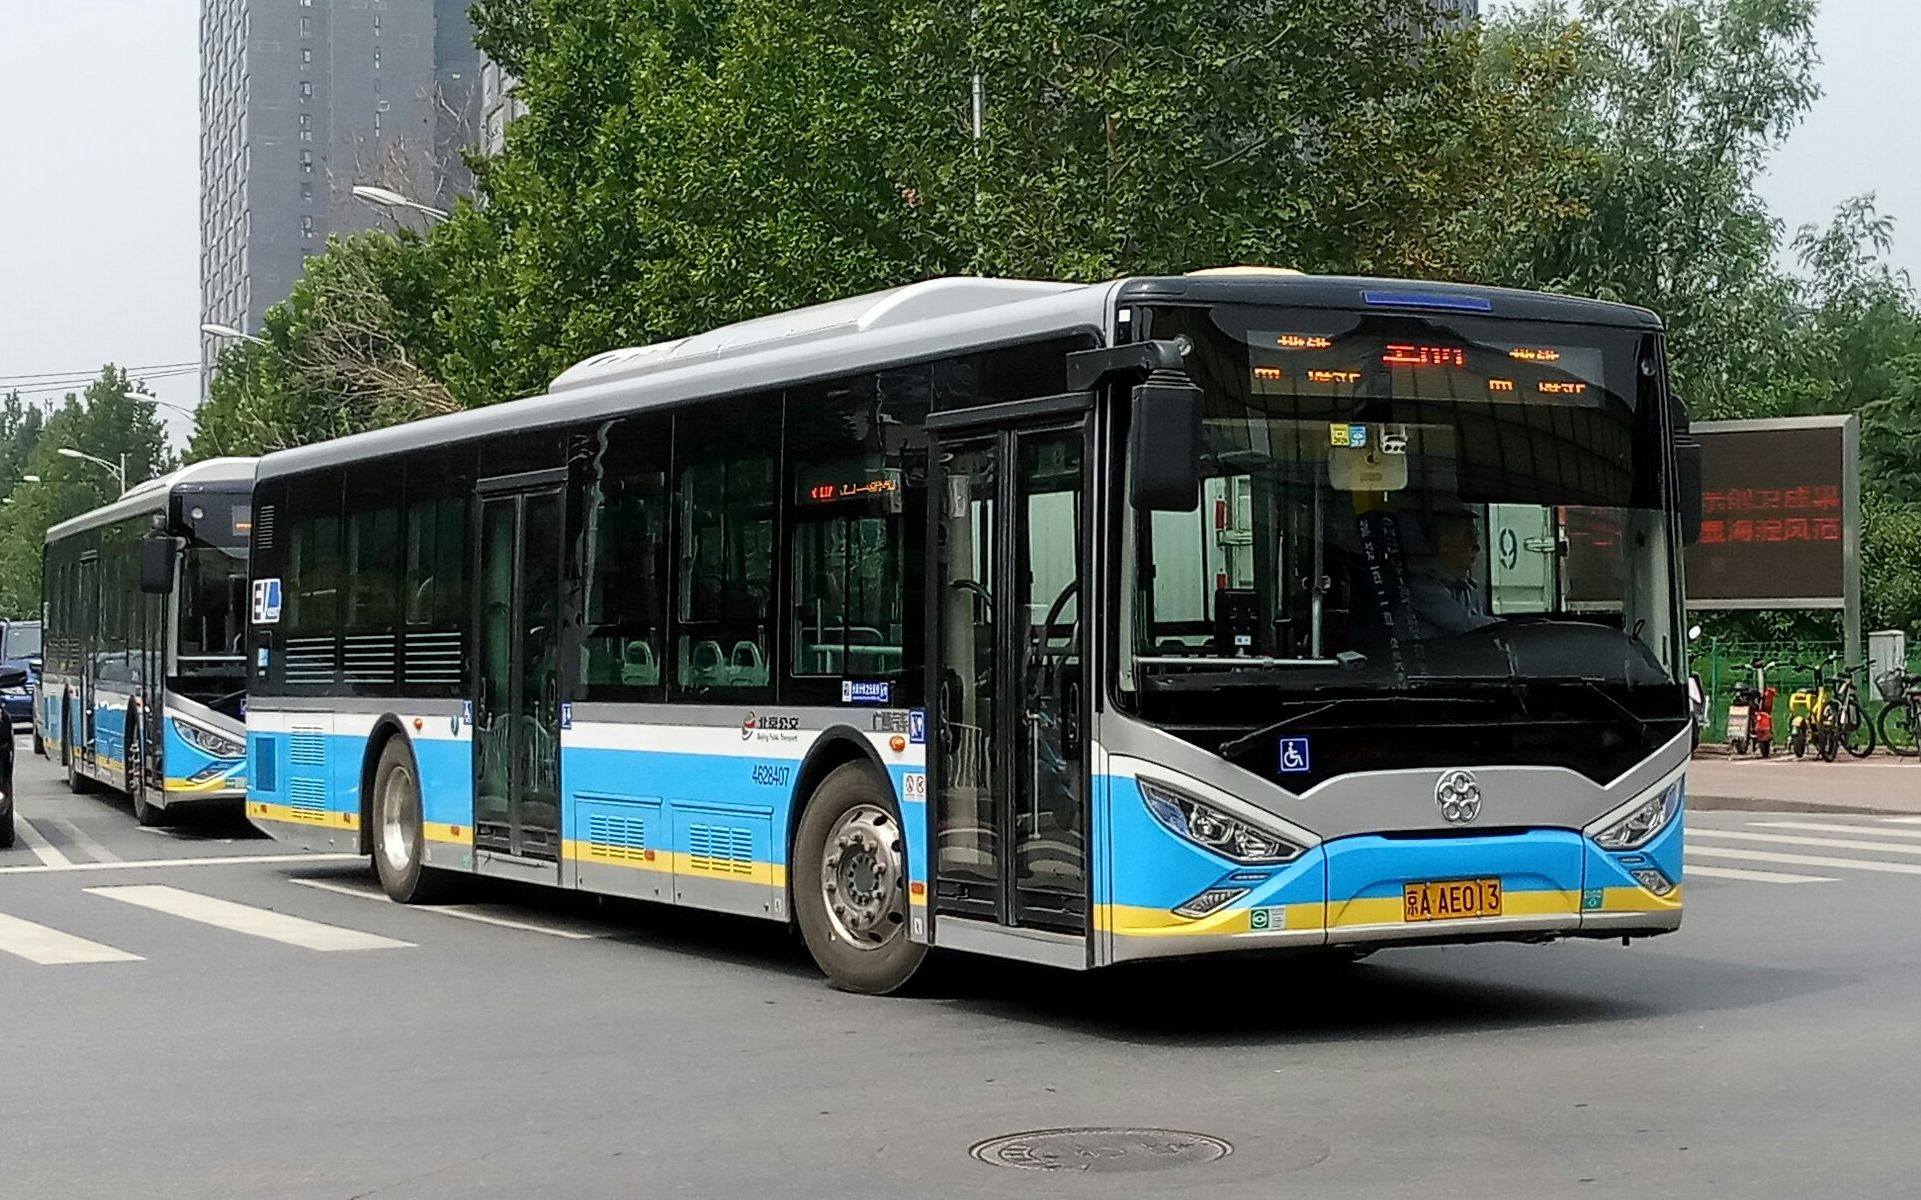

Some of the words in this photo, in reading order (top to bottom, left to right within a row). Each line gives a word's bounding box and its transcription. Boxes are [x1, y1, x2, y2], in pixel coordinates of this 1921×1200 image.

[1500, 528, 1517, 570] 9
[758, 716, 800, 730] 北京公交
[752, 764, 790, 786] 4628407
